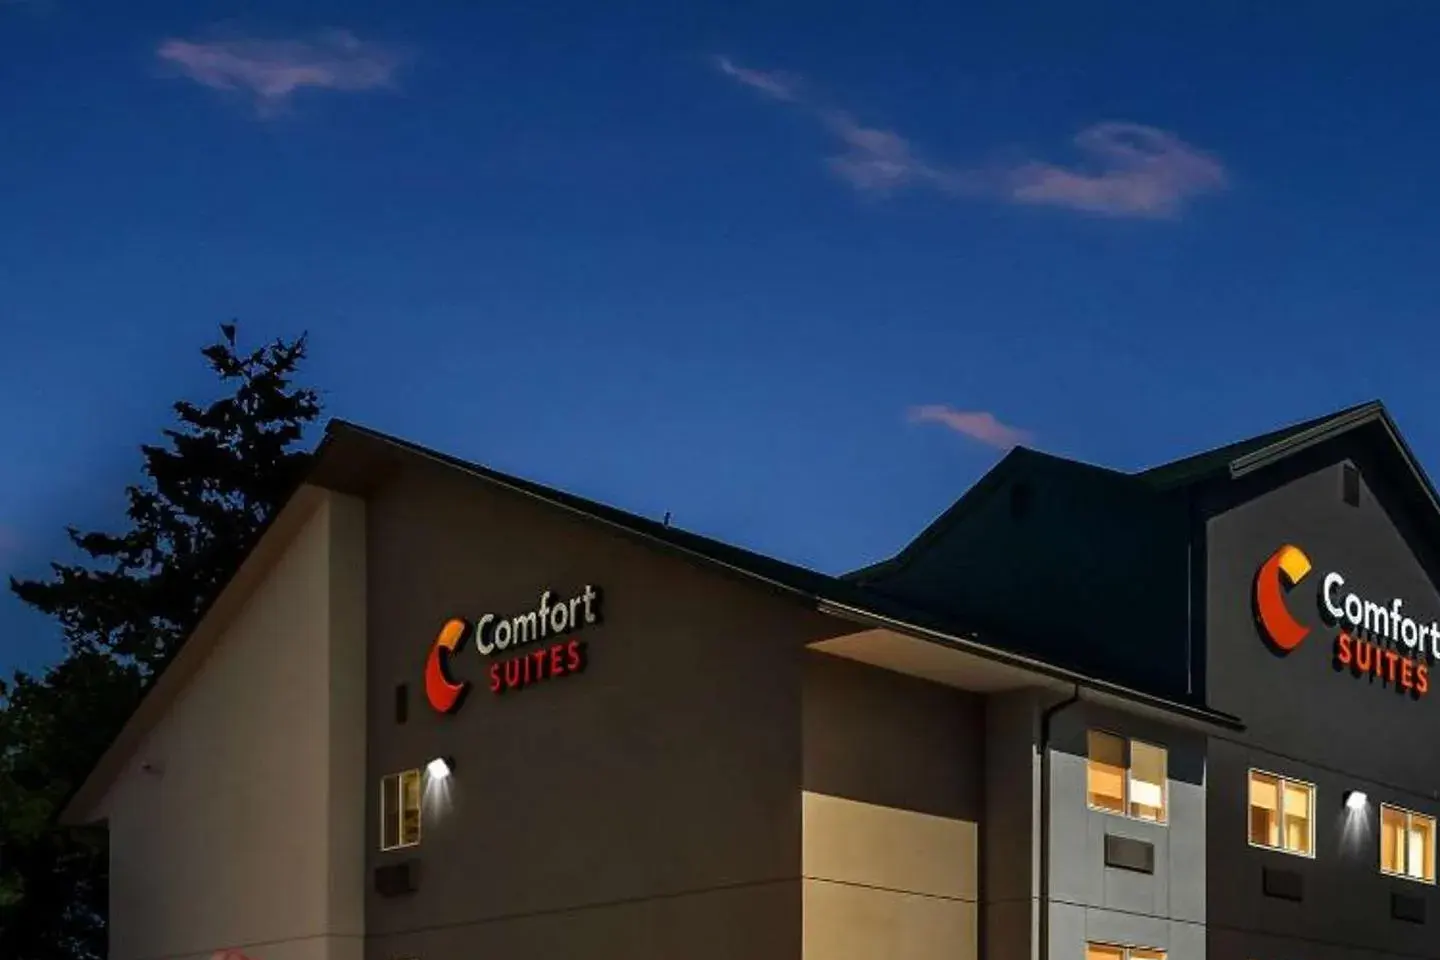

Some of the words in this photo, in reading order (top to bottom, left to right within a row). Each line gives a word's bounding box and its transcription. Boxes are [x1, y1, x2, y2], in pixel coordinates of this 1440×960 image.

[475, 584, 597, 655] Comfort
[489, 639, 582, 692] SUITES
[1337, 631, 1430, 694] SUITES
